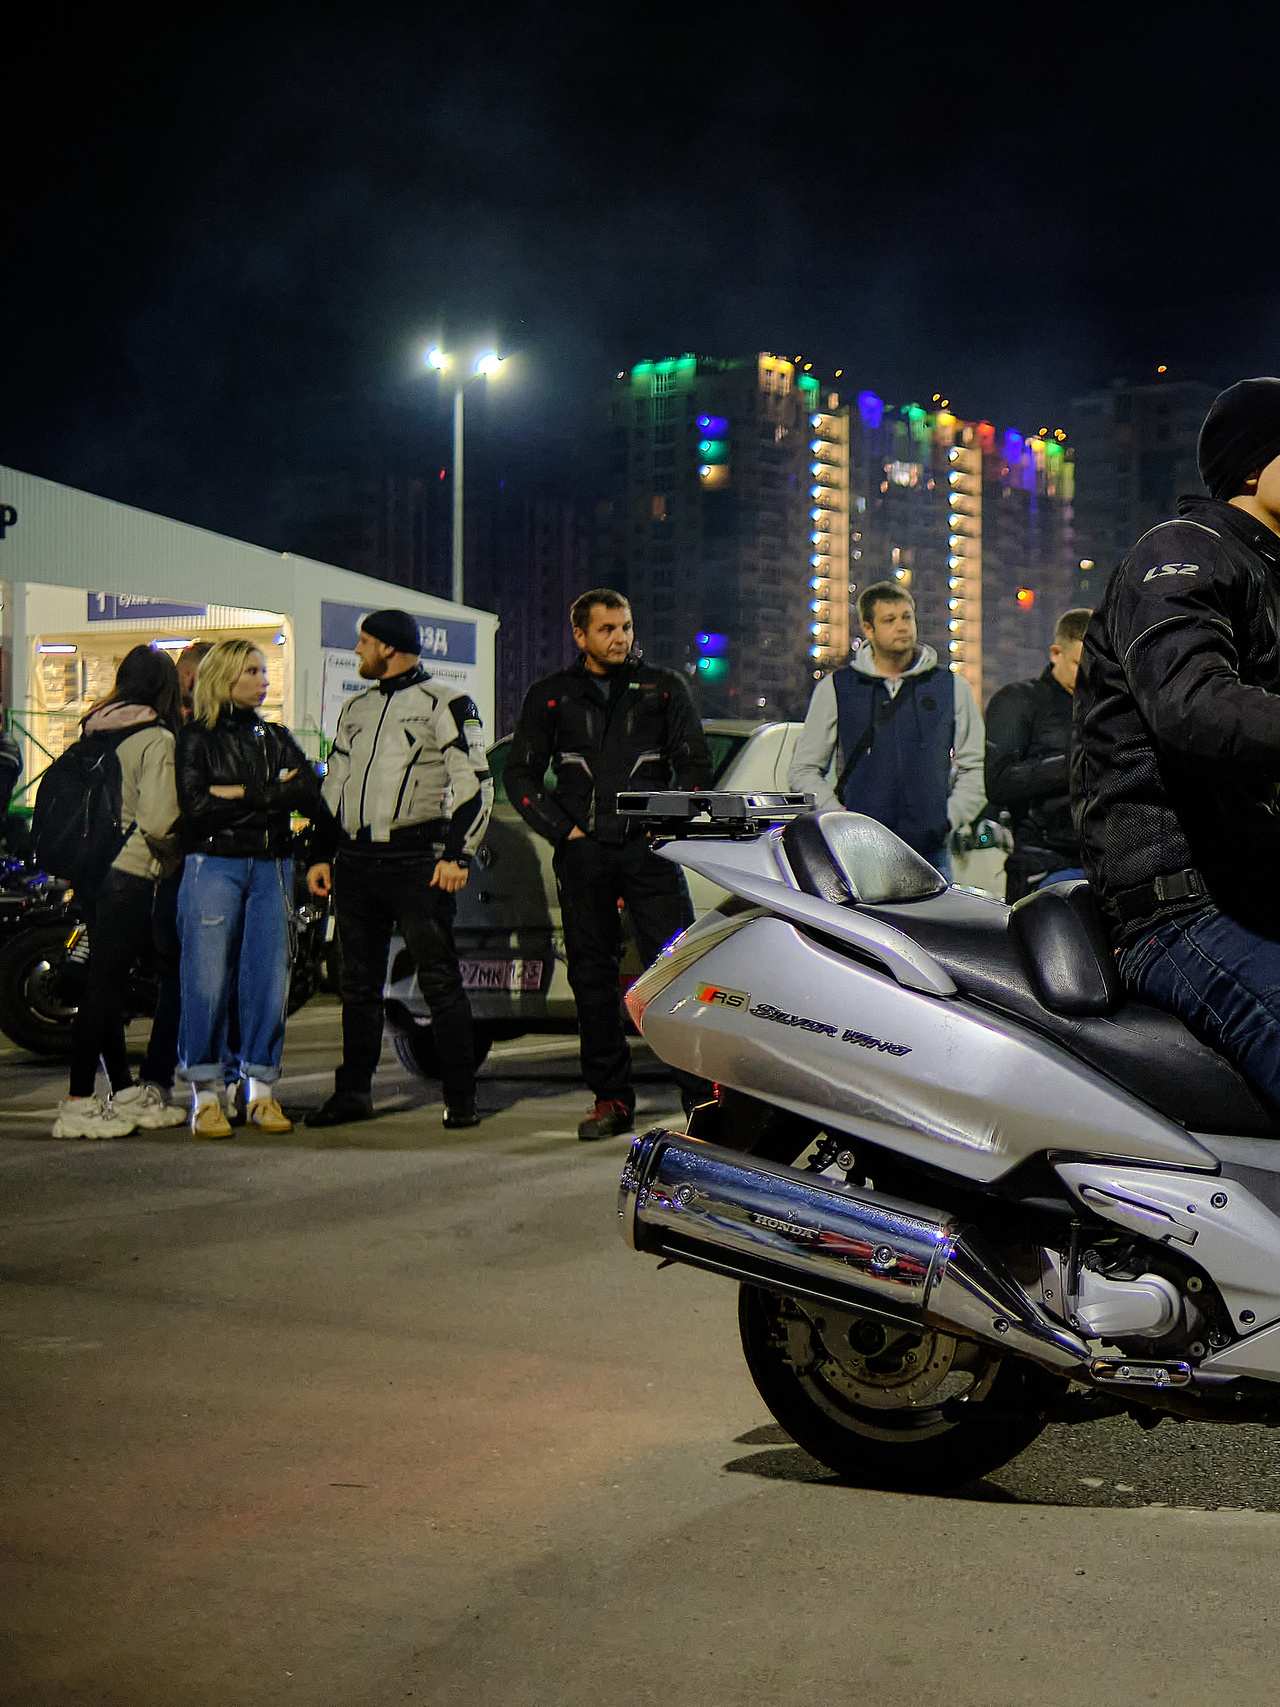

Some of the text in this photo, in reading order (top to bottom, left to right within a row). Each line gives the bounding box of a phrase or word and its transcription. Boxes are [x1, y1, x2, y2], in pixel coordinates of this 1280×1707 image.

[1142, 563, 1200, 582] LS2
[96, 591, 106, 613] 1
[709, 991, 745, 1008] RS
[750, 1003, 913, 1057] SILVER WING
[754, 1213, 816, 1239] HONDA
